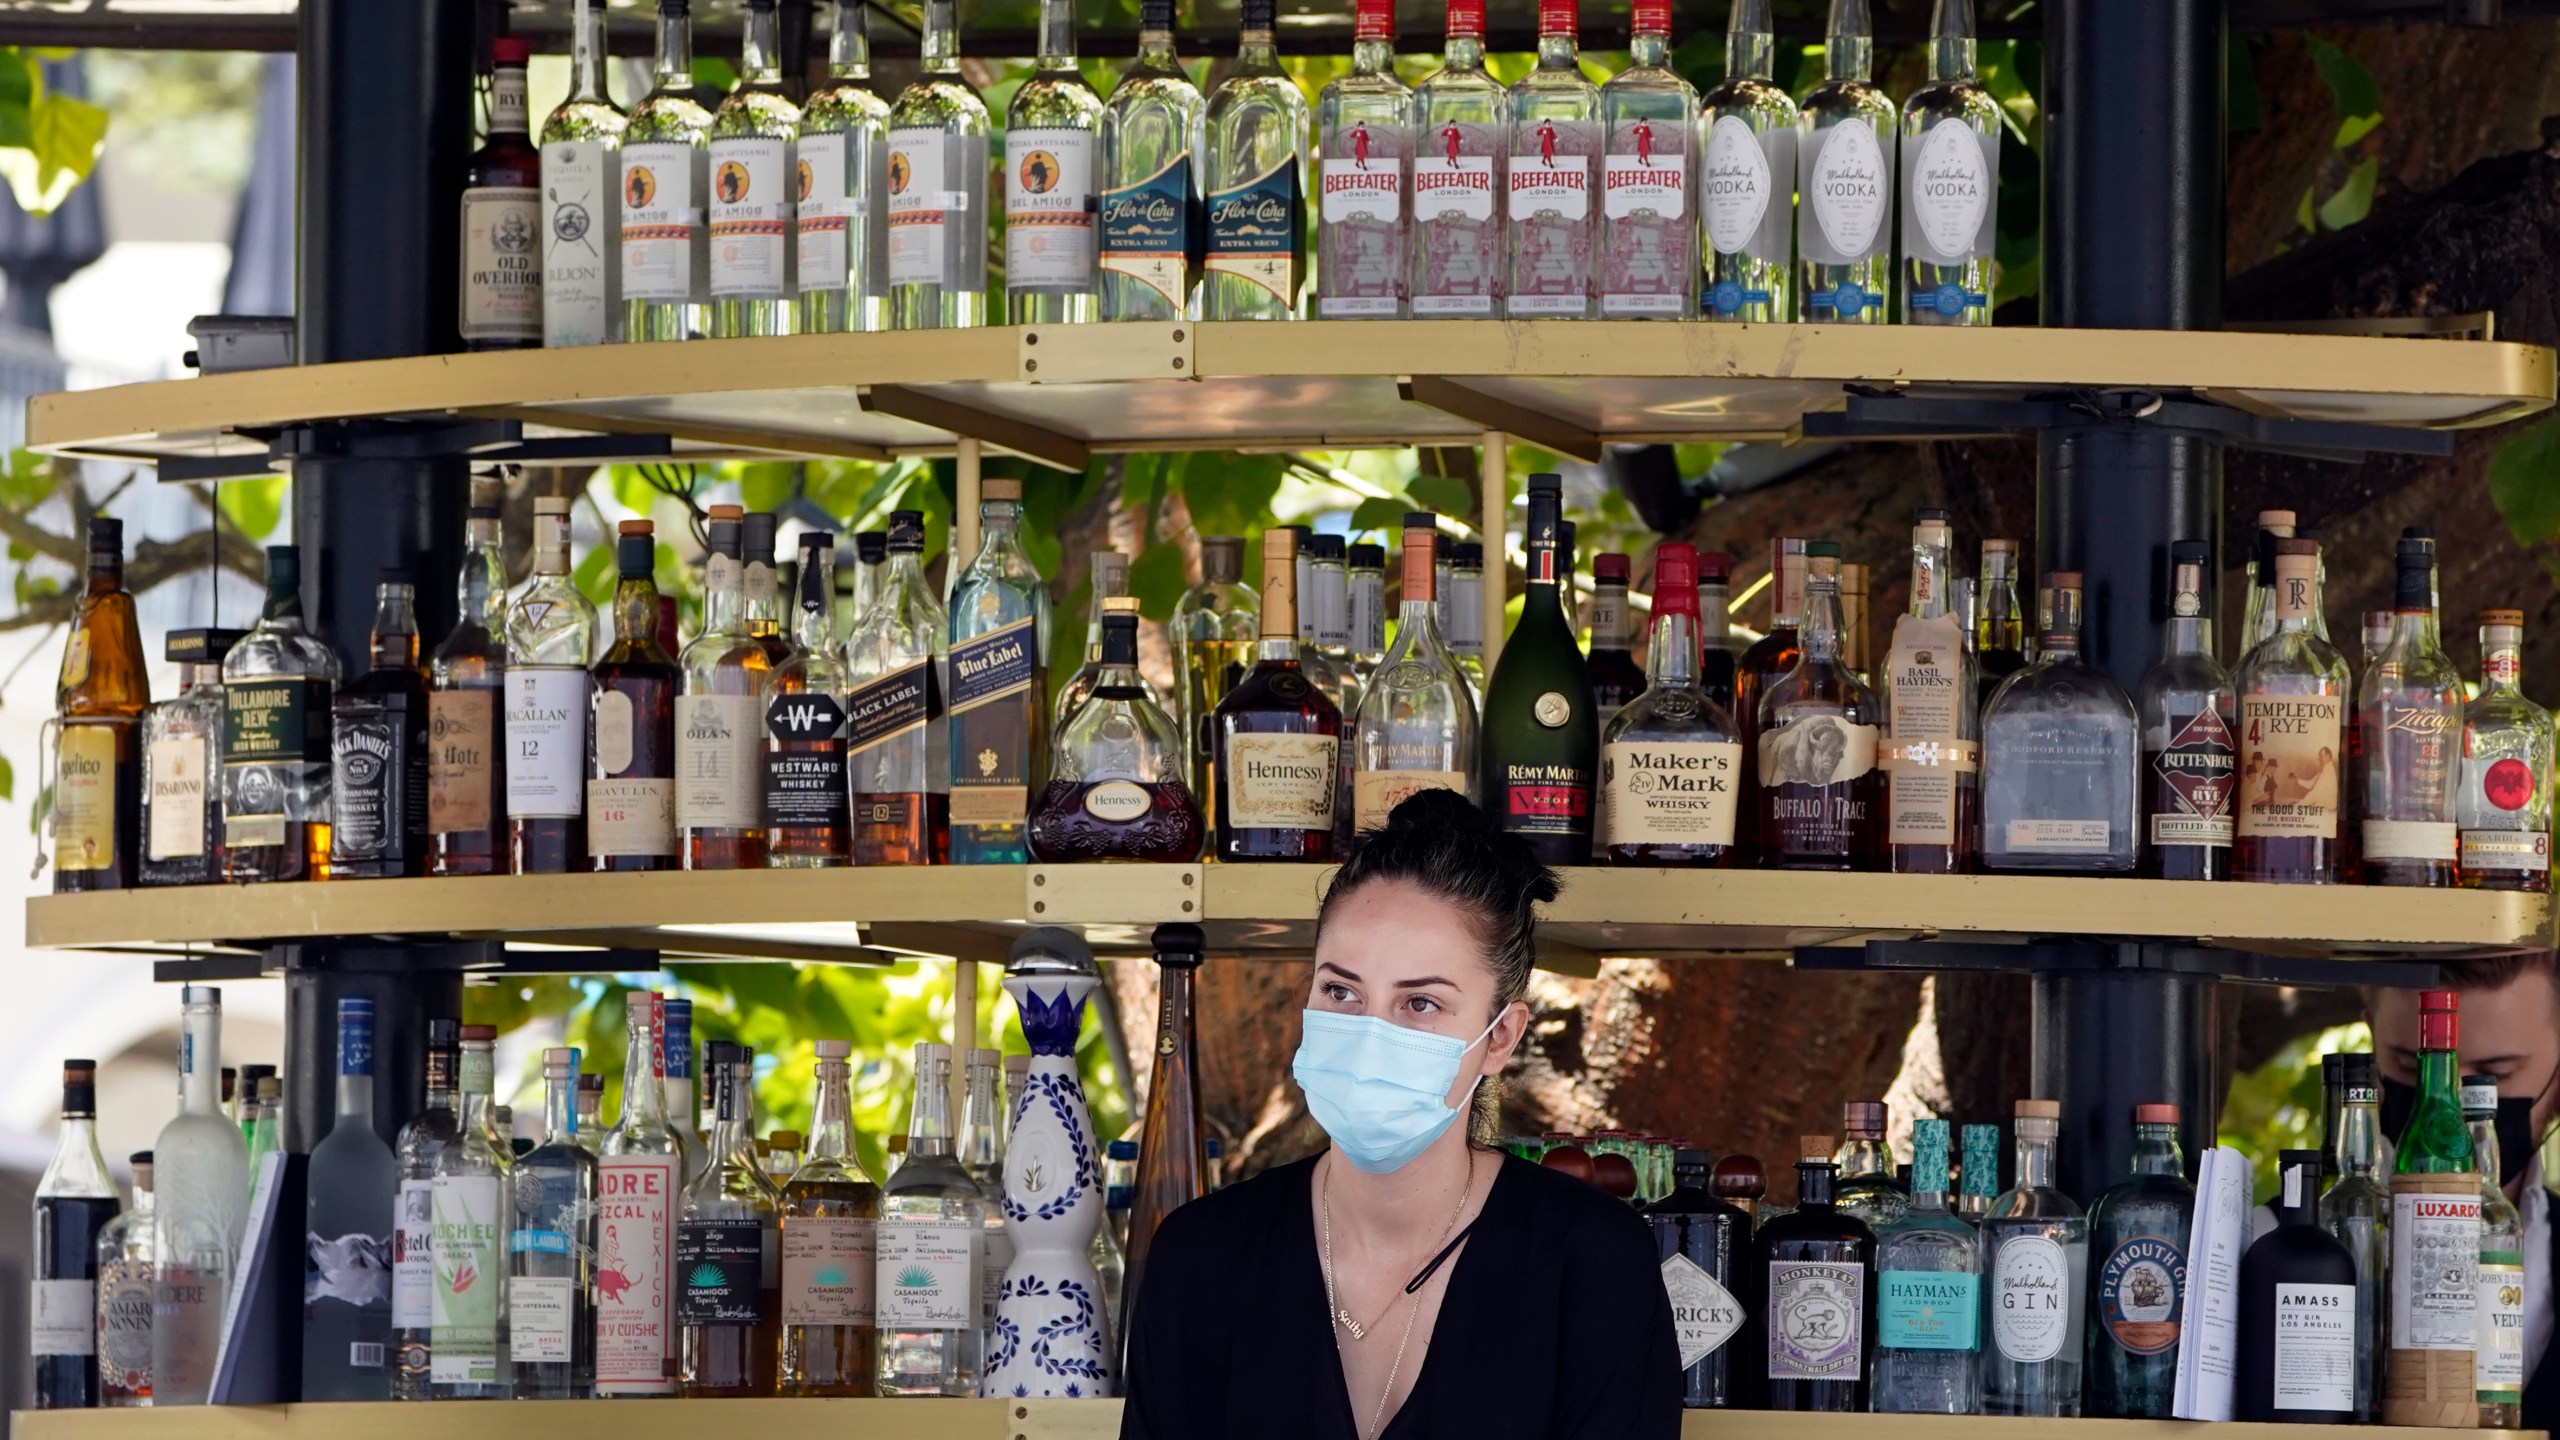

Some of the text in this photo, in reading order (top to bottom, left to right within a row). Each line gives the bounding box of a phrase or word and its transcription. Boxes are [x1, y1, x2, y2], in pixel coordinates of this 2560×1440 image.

[1325, 173, 1398, 194] BEEFEATER
[1417, 171, 1490, 193] BEEFEATER
[1511, 171, 1585, 192] BEEFEATER
[1607, 169, 1682, 191] BEEFEATER
[1706, 180, 1756, 195] VODKA
[1824, 182, 1877, 198] VODKA
[1925, 182, 1977, 197] VODKA
[1103, 198, 1137, 222] Flor
[1146, 198, 1175, 222] Caña
[1211, 198, 1246, 224] Flor
[1256, 198, 1286, 223] Caña
[1110, 238, 1168, 247] EXTRA SECO
[1219, 239, 1279, 248] EXTRA SECO
[497, 256, 529, 269] OLD
[1153, 260, 1162, 273] 4
[1263, 261, 1274, 275] 4
[530, 605, 542, 617] 12
[956, 642, 1023, 680] Blue Label
[1908, 668, 1942, 678] BASIL
[1896, 676, 1953, 688] HAYDEN'S
[226, 687, 291, 711] TULLAMORE
[846, 701, 882, 724] BLACK
[883, 685, 920, 707] LABEL
[788, 704, 815, 731] W
[2246, 702, 2336, 720] TEMPLETON
[242, 709, 270, 729] DEW
[686, 729, 731, 740] OBAN
[2248, 718, 2308, 746] 4 RYE
[353, 730, 392, 760] DANIEL'S
[521, 740, 539, 757] 12
[694, 750, 720, 779] 14
[770, 762, 838, 773] WESTWARD
[1629, 752, 1728, 770] Maker's
[1247, 760, 1325, 783] Hennessy
[1508, 765, 1544, 780] RÉMY
[155, 780, 201, 796] DISARONNO
[780, 779, 825, 788] WHISKEY
[1658, 774, 1726, 792] Mark
[1095, 795, 1142, 808] Hennessy
[2192, 789, 2221, 801] RYE
[1646, 800, 1711, 810] WHISKY
[1772, 797, 1866, 820] BUFFALO TRACE
[2251, 804, 2325, 817] THE GOOD STUFF
[604, 810, 625, 821] 16
[2161, 822, 2203, 831] BOTTLED
[2465, 834, 2513, 843] BACARDI
[2534, 837, 2547, 856] 8
[474, 1224, 493, 1240] EL
[533, 1236, 564, 1250] LAURO
[652, 1210, 663, 1309] MEXICO
[1779, 1267, 1854, 1286] MONKEY 47
[2103, 1242, 2175, 1298] PLYMOUTH
[2002, 1273, 2058, 1291] Mulholland
[2480, 1274, 2503, 1285] JOHN
[687, 1288, 729, 1296] CASAMIGOS
[807, 1286, 855, 1294] CASAMIGOS
[893, 1289, 939, 1297] CASAMIGOS
[694, 1296, 718, 1306] Tequila
[818, 1295, 845, 1304] Tequila
[903, 1297, 929, 1307] Tequila
[2003, 1292, 2058, 1310] GIN
[2282, 1295, 2340, 1307] AMASS
[608, 1323, 659, 1338] Y CUISHE
[1337, 1309, 1365, 1340] Salty
[1774, 1354, 1856, 1375] SCHWARZWALD DRY GIN
